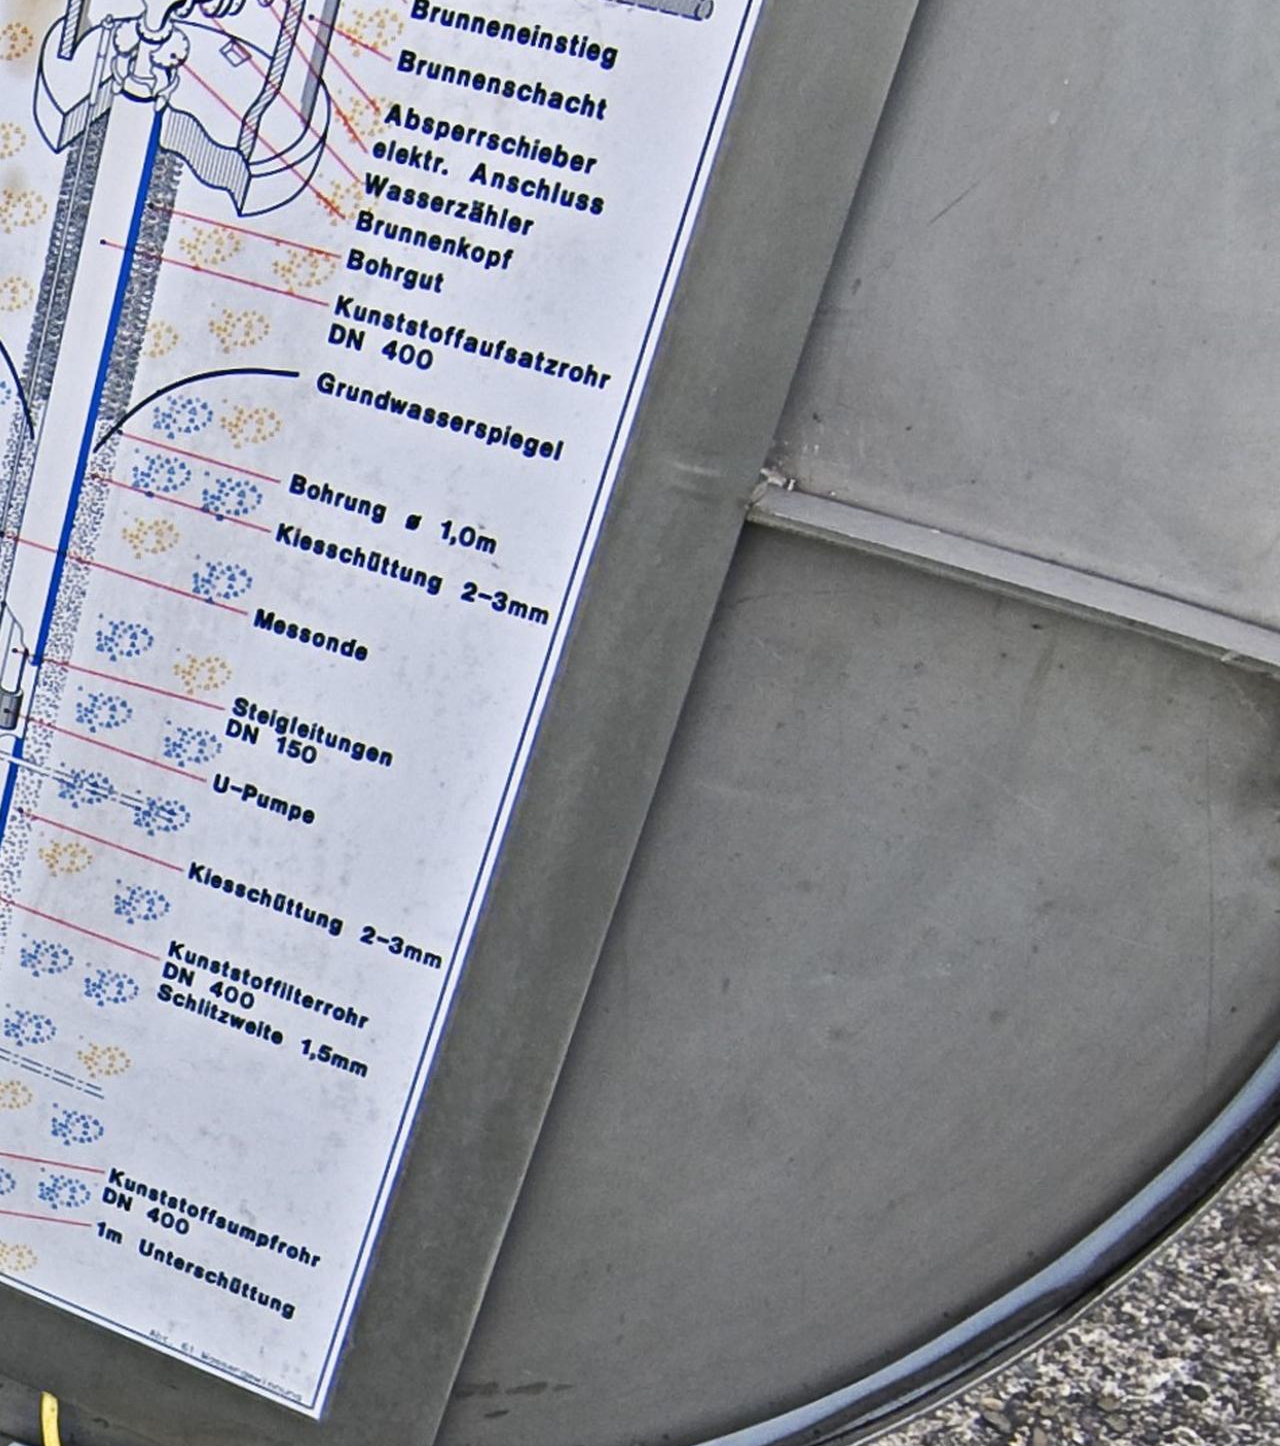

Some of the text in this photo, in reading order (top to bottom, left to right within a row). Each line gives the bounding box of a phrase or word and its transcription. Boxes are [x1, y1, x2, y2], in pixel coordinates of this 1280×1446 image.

[397, 50, 608, 120] Brunnenschacht
[385, 104, 597, 174] Absperrschieber
[365, 173, 534, 236] Wasserzähler
[373, 140, 605, 215] elektr. Anschluss
[347, 249, 444, 293] Bohrgut
[356, 211, 513, 270] Brunnenkopf
[328, 324, 433, 371] DN 400
[335, 295, 611, 390] Kunststoffaufsatzrohr
[317, 372, 564, 460] Grundwasserspiegel
[290, 474, 387, 523] Bohrung
[441, 520, 497, 554] 1,0m
[275, 523, 549, 625] Kiesschüttung 2-3mm
[253, 609, 368, 661] Messonde
[226, 719, 317, 765] DN 150
[232, 698, 393, 767] Steigleitungen
[213, 774, 315, 824] U-Pumpe
[188, 862, 442, 969] Kiesschüttung 2-3mm
[162, 962, 254, 1009] DN 400
[168, 941, 369, 1029] Kunststoffilterrohr
[157, 984, 368, 1077] Schlitzweite 1,5mm
[102, 1187, 190, 1235] DN 400
[108, 1168, 320, 1267] Kunststoffsumpfrohr
[97, 1222, 296, 1319] 1m Unterschüttung
